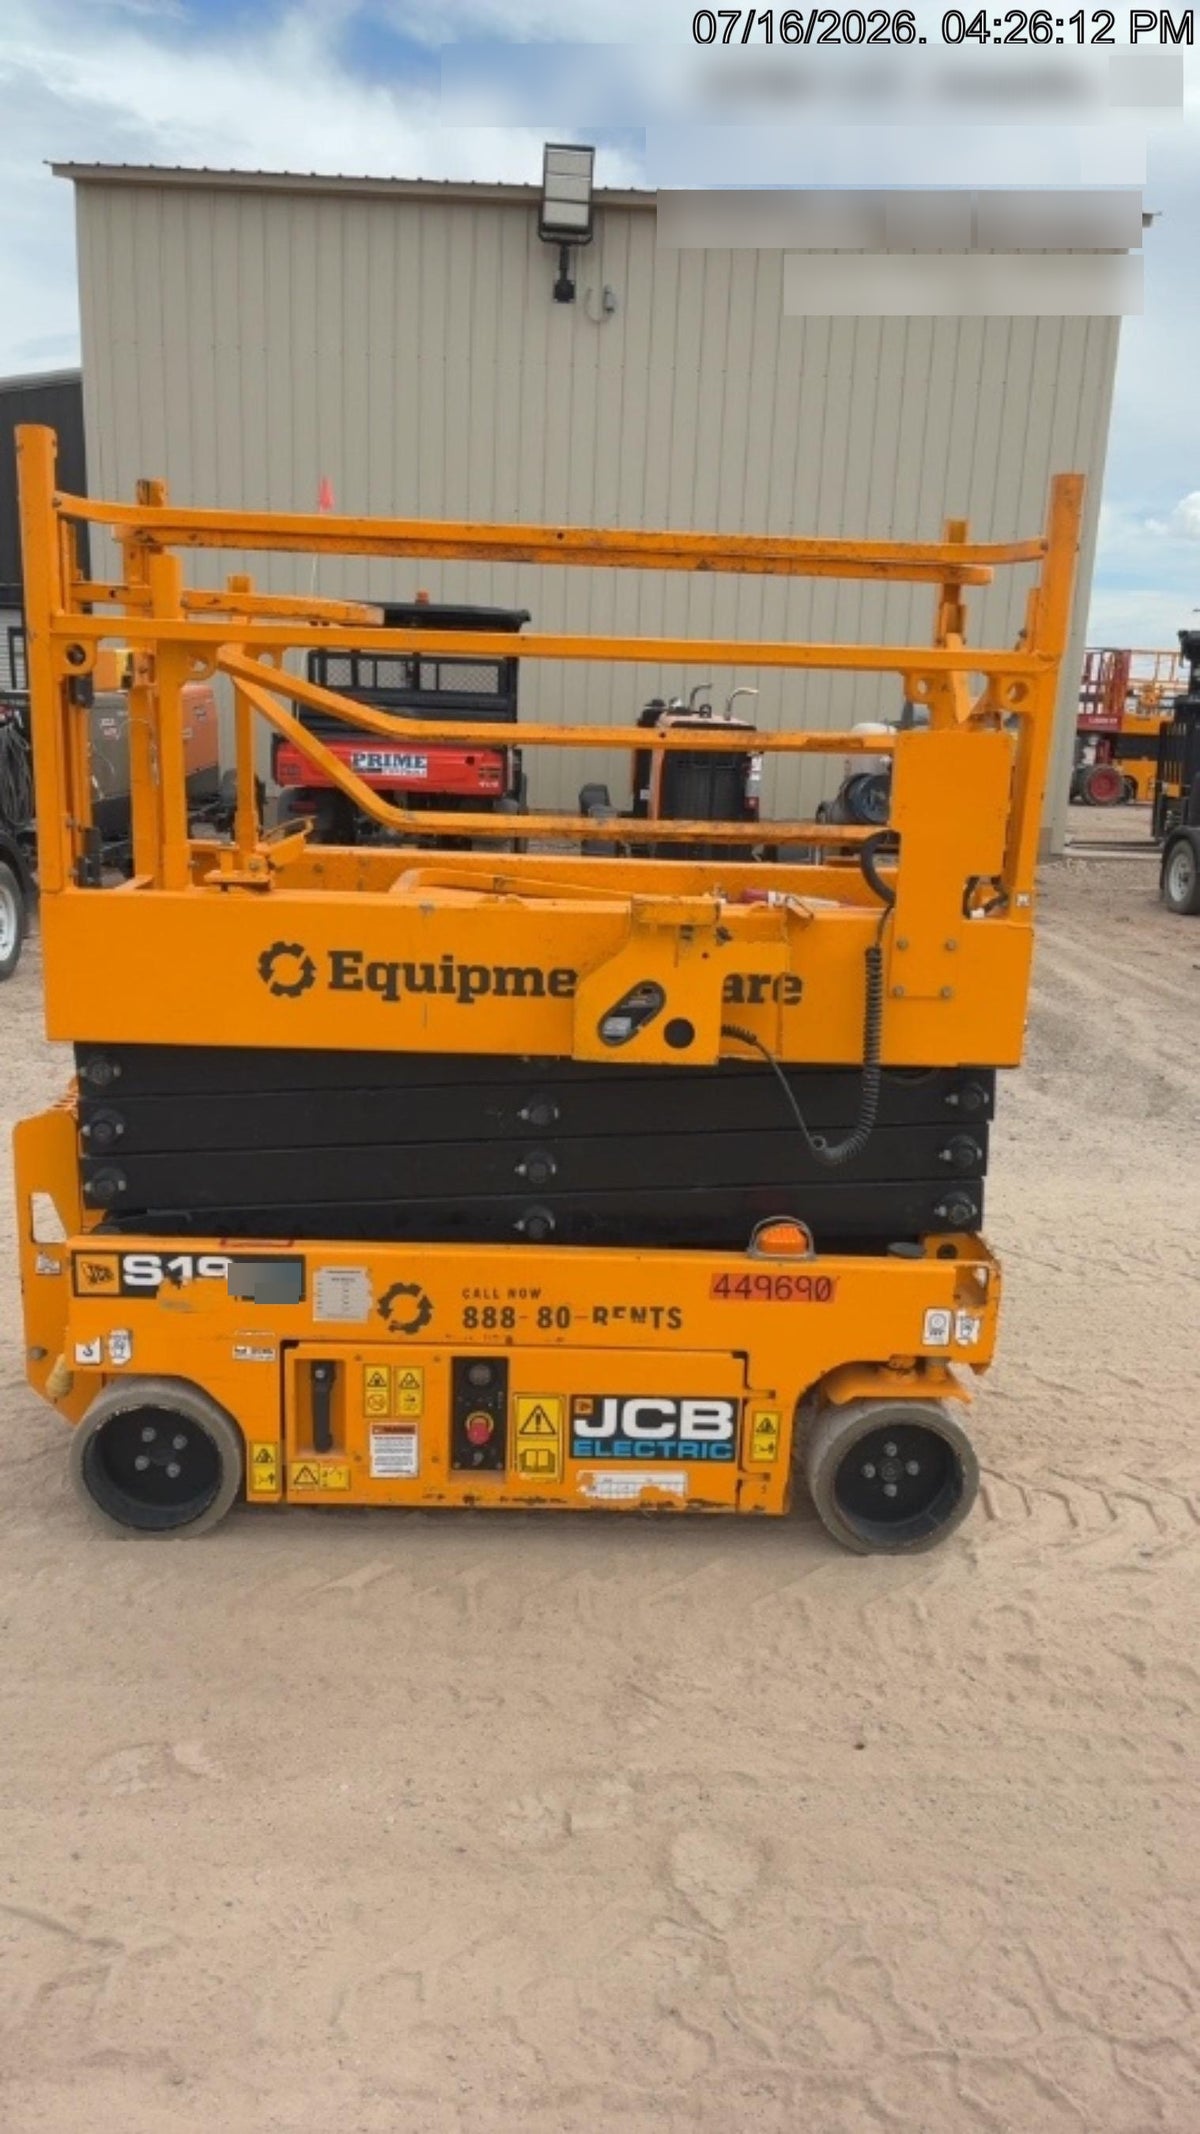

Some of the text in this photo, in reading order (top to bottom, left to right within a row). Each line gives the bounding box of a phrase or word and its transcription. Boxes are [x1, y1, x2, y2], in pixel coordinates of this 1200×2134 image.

[352, 752, 427, 769] PRIME
[328, 950, 803, 1005] Equipme are
[123, 1254, 234, 1287] S19
[461, 1287, 542, 1300] CALL NOW
[713, 1272, 833, 1302] 449690
[573, 1397, 734, 1440] JCB
[573, 1438, 732, 1460] ELECTRIC
